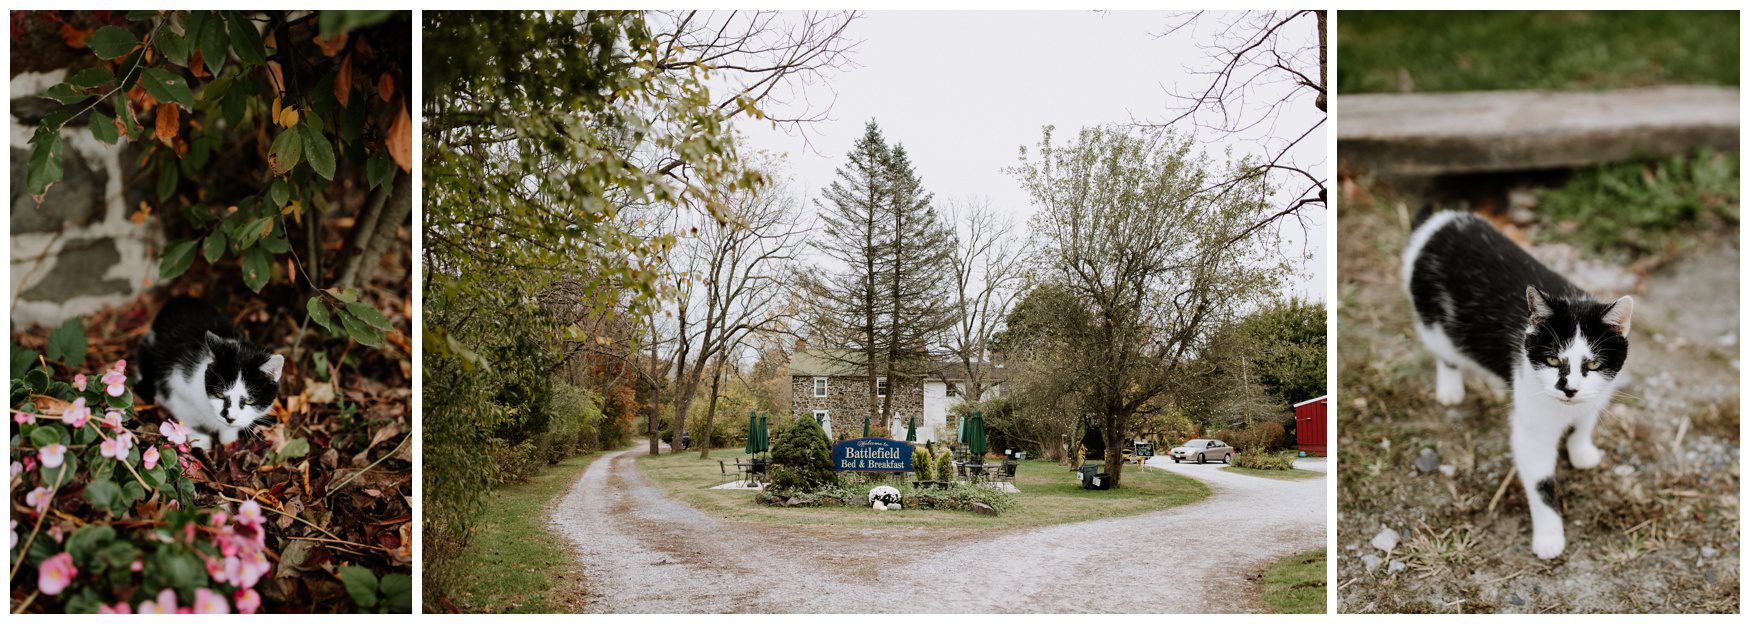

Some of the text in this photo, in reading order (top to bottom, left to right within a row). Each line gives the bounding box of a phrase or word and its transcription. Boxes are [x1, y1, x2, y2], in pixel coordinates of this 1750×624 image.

[845, 447, 900, 459] Battlefield
[841, 459, 904, 469] Bed & Breakfast
